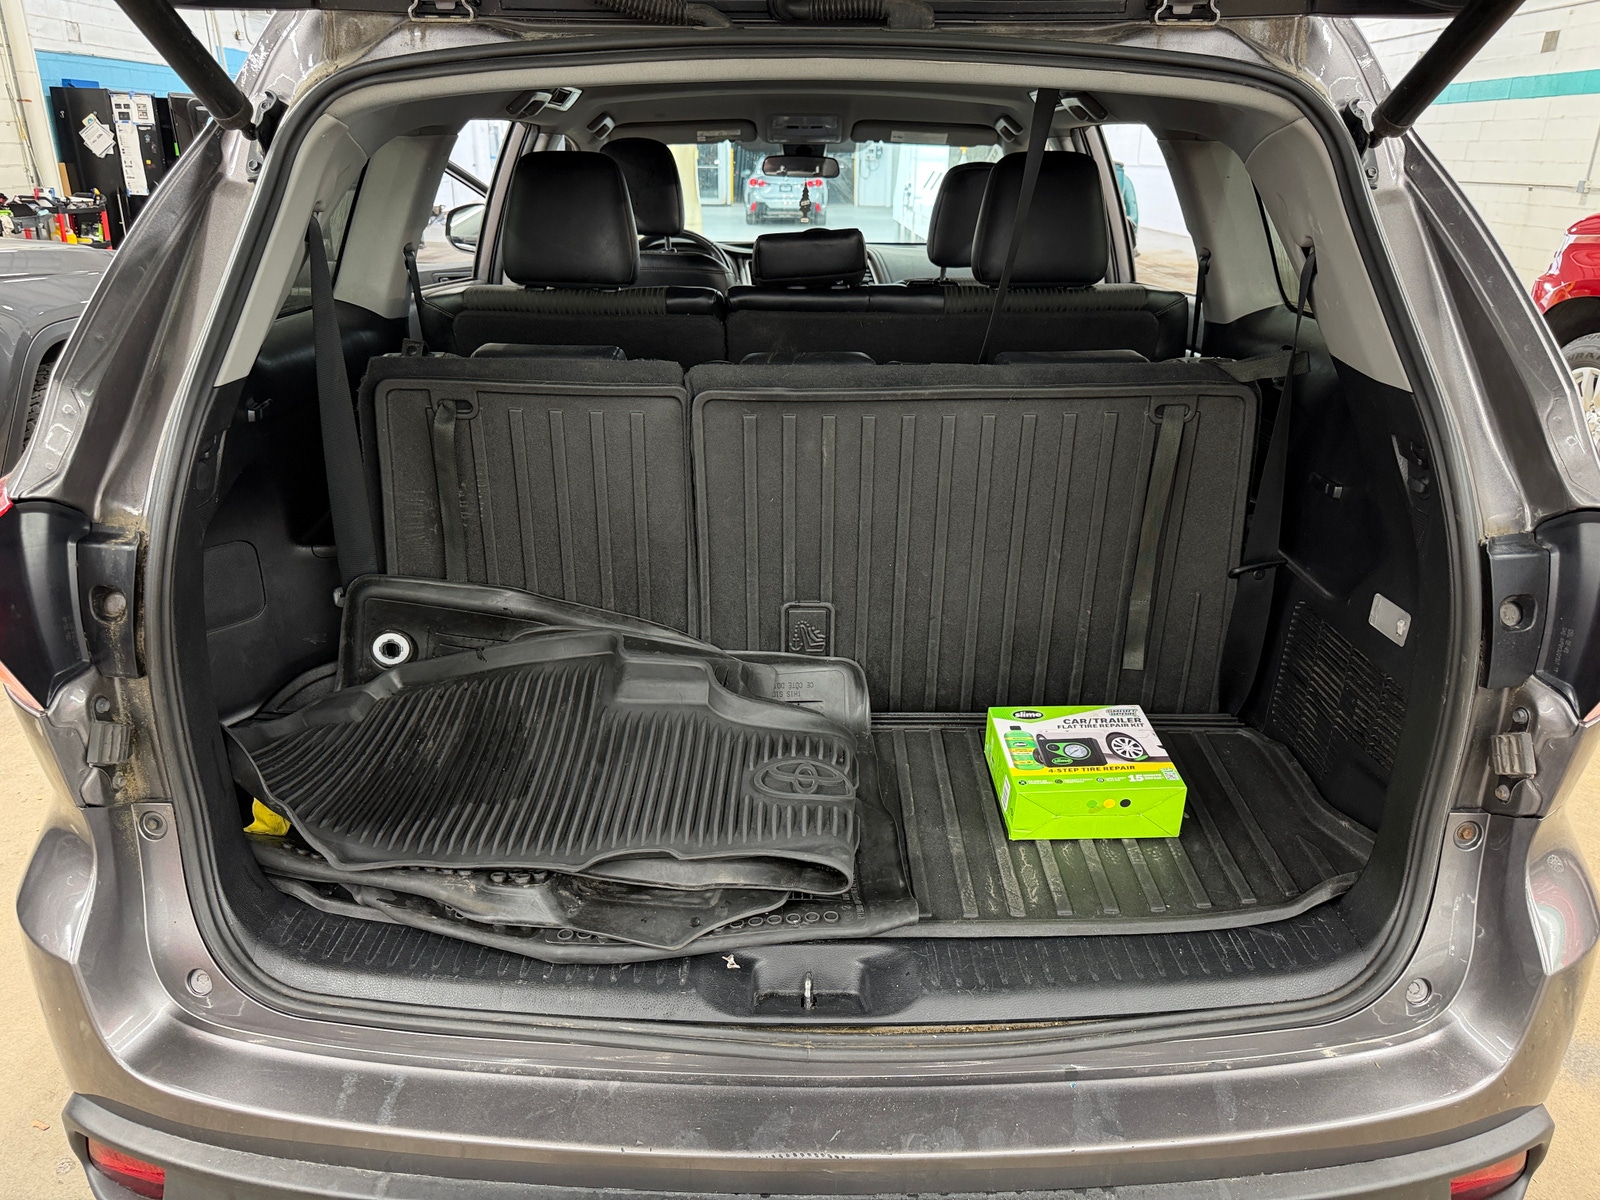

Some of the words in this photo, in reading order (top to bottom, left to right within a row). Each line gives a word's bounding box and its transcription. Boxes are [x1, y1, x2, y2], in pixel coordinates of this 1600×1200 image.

[787, 690, 801, 698] THIS
[1014, 711, 1042, 719] slime
[1063, 717, 1142, 725] CAR/TRAILER
[1128, 774, 1144, 783] 15
